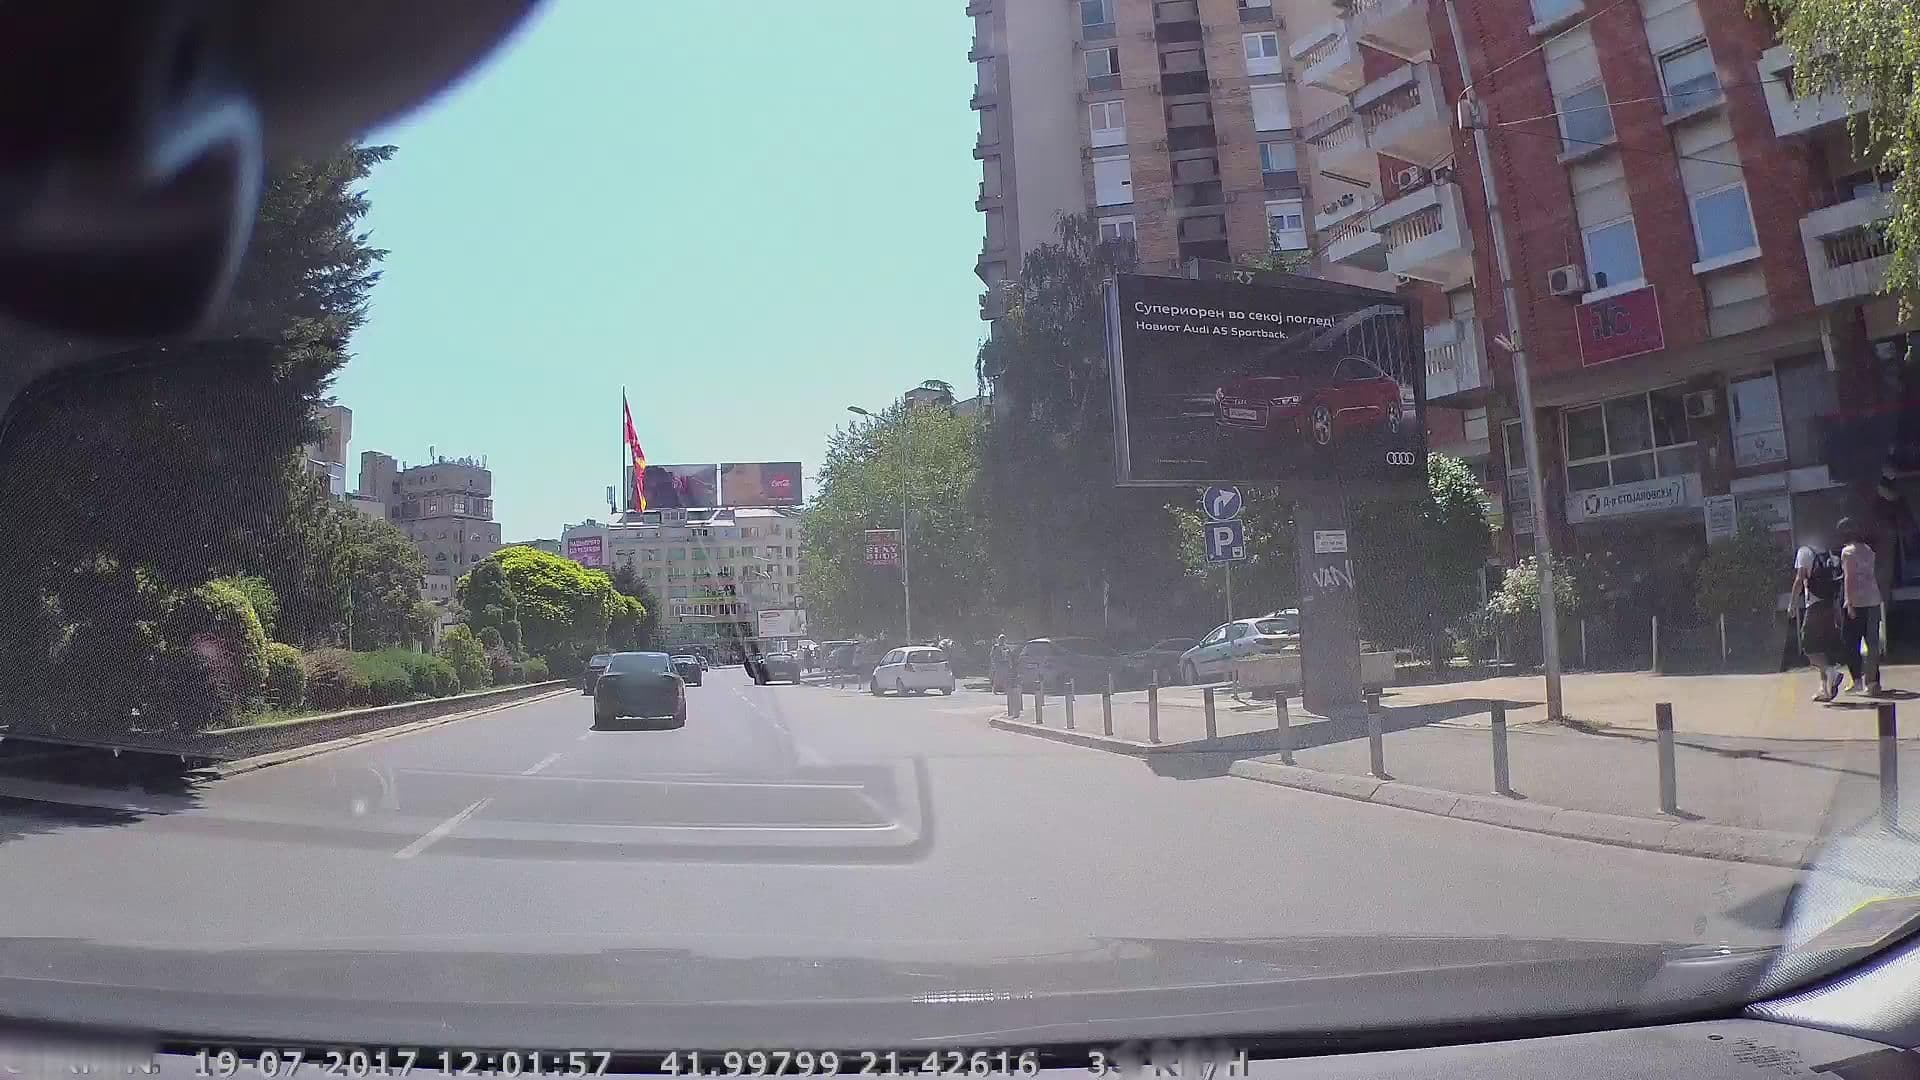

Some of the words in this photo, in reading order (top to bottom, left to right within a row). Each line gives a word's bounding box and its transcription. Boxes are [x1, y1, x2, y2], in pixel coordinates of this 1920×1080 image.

[1134, 301, 1225, 319] Супериорен
[1228, 311, 1245, 320] во
[1248, 311, 1283, 325] секој
[1286, 314, 1336, 328] поглед!
[1136, 320, 1181, 332] Новиот
[1183, 323, 1210, 334] Audi
[1231, 327, 1289, 339] Sportback.
[1213, 526, 1234, 556] P
